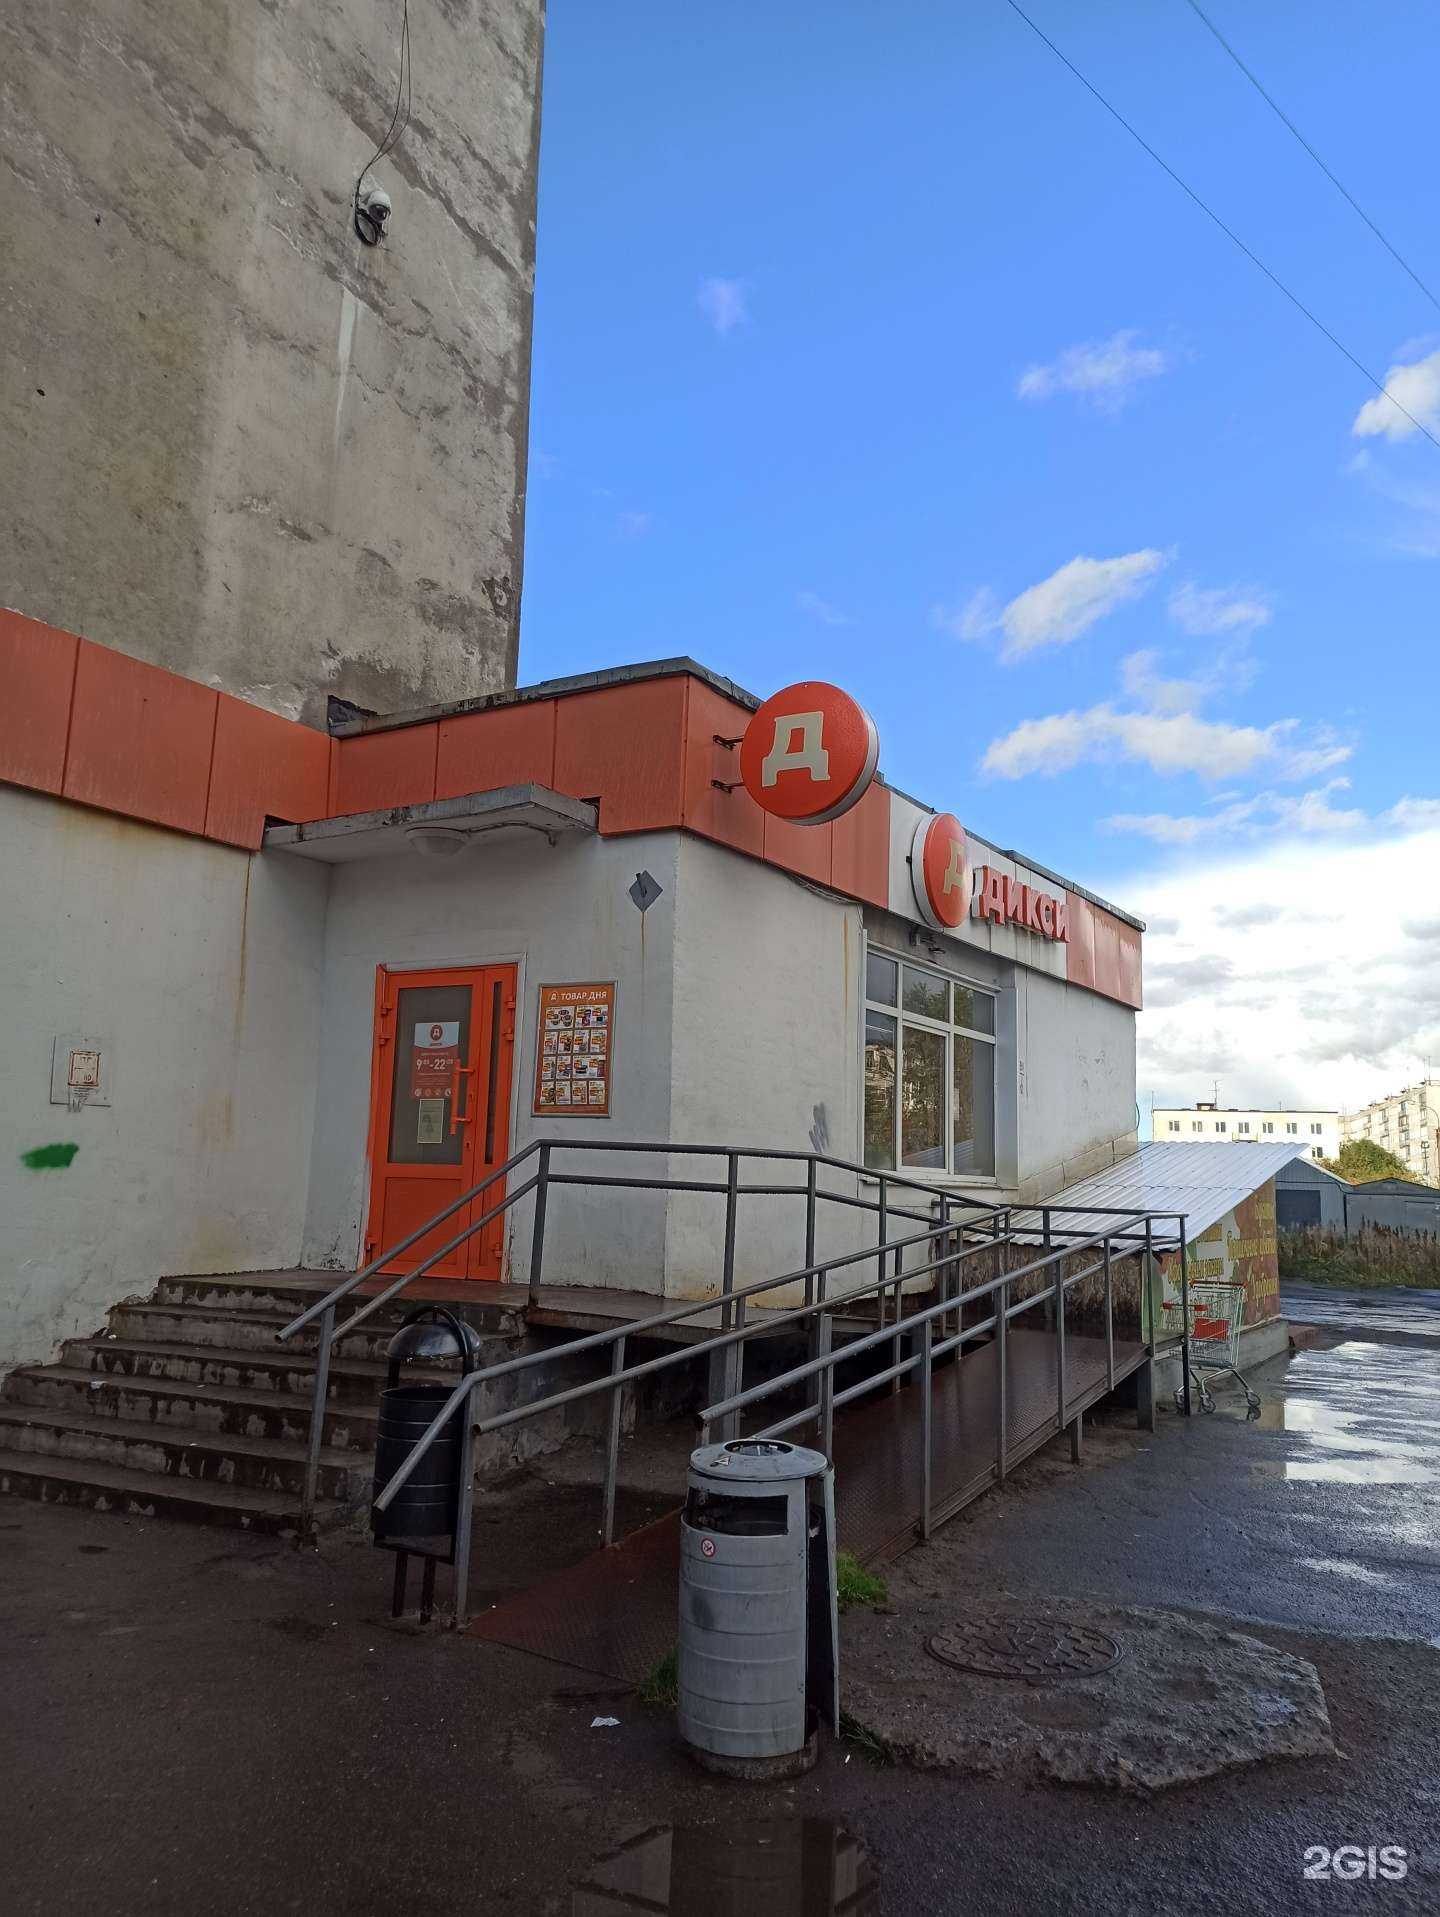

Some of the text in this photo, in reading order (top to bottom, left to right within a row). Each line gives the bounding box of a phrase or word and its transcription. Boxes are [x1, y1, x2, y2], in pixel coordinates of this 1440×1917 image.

[761, 710, 831, 788] Д
[976, 864, 1071, 944] ДИКСИ
[560, 992, 587, 1001] ТОВАР
[588, 991, 607, 1001] ДНЯ
